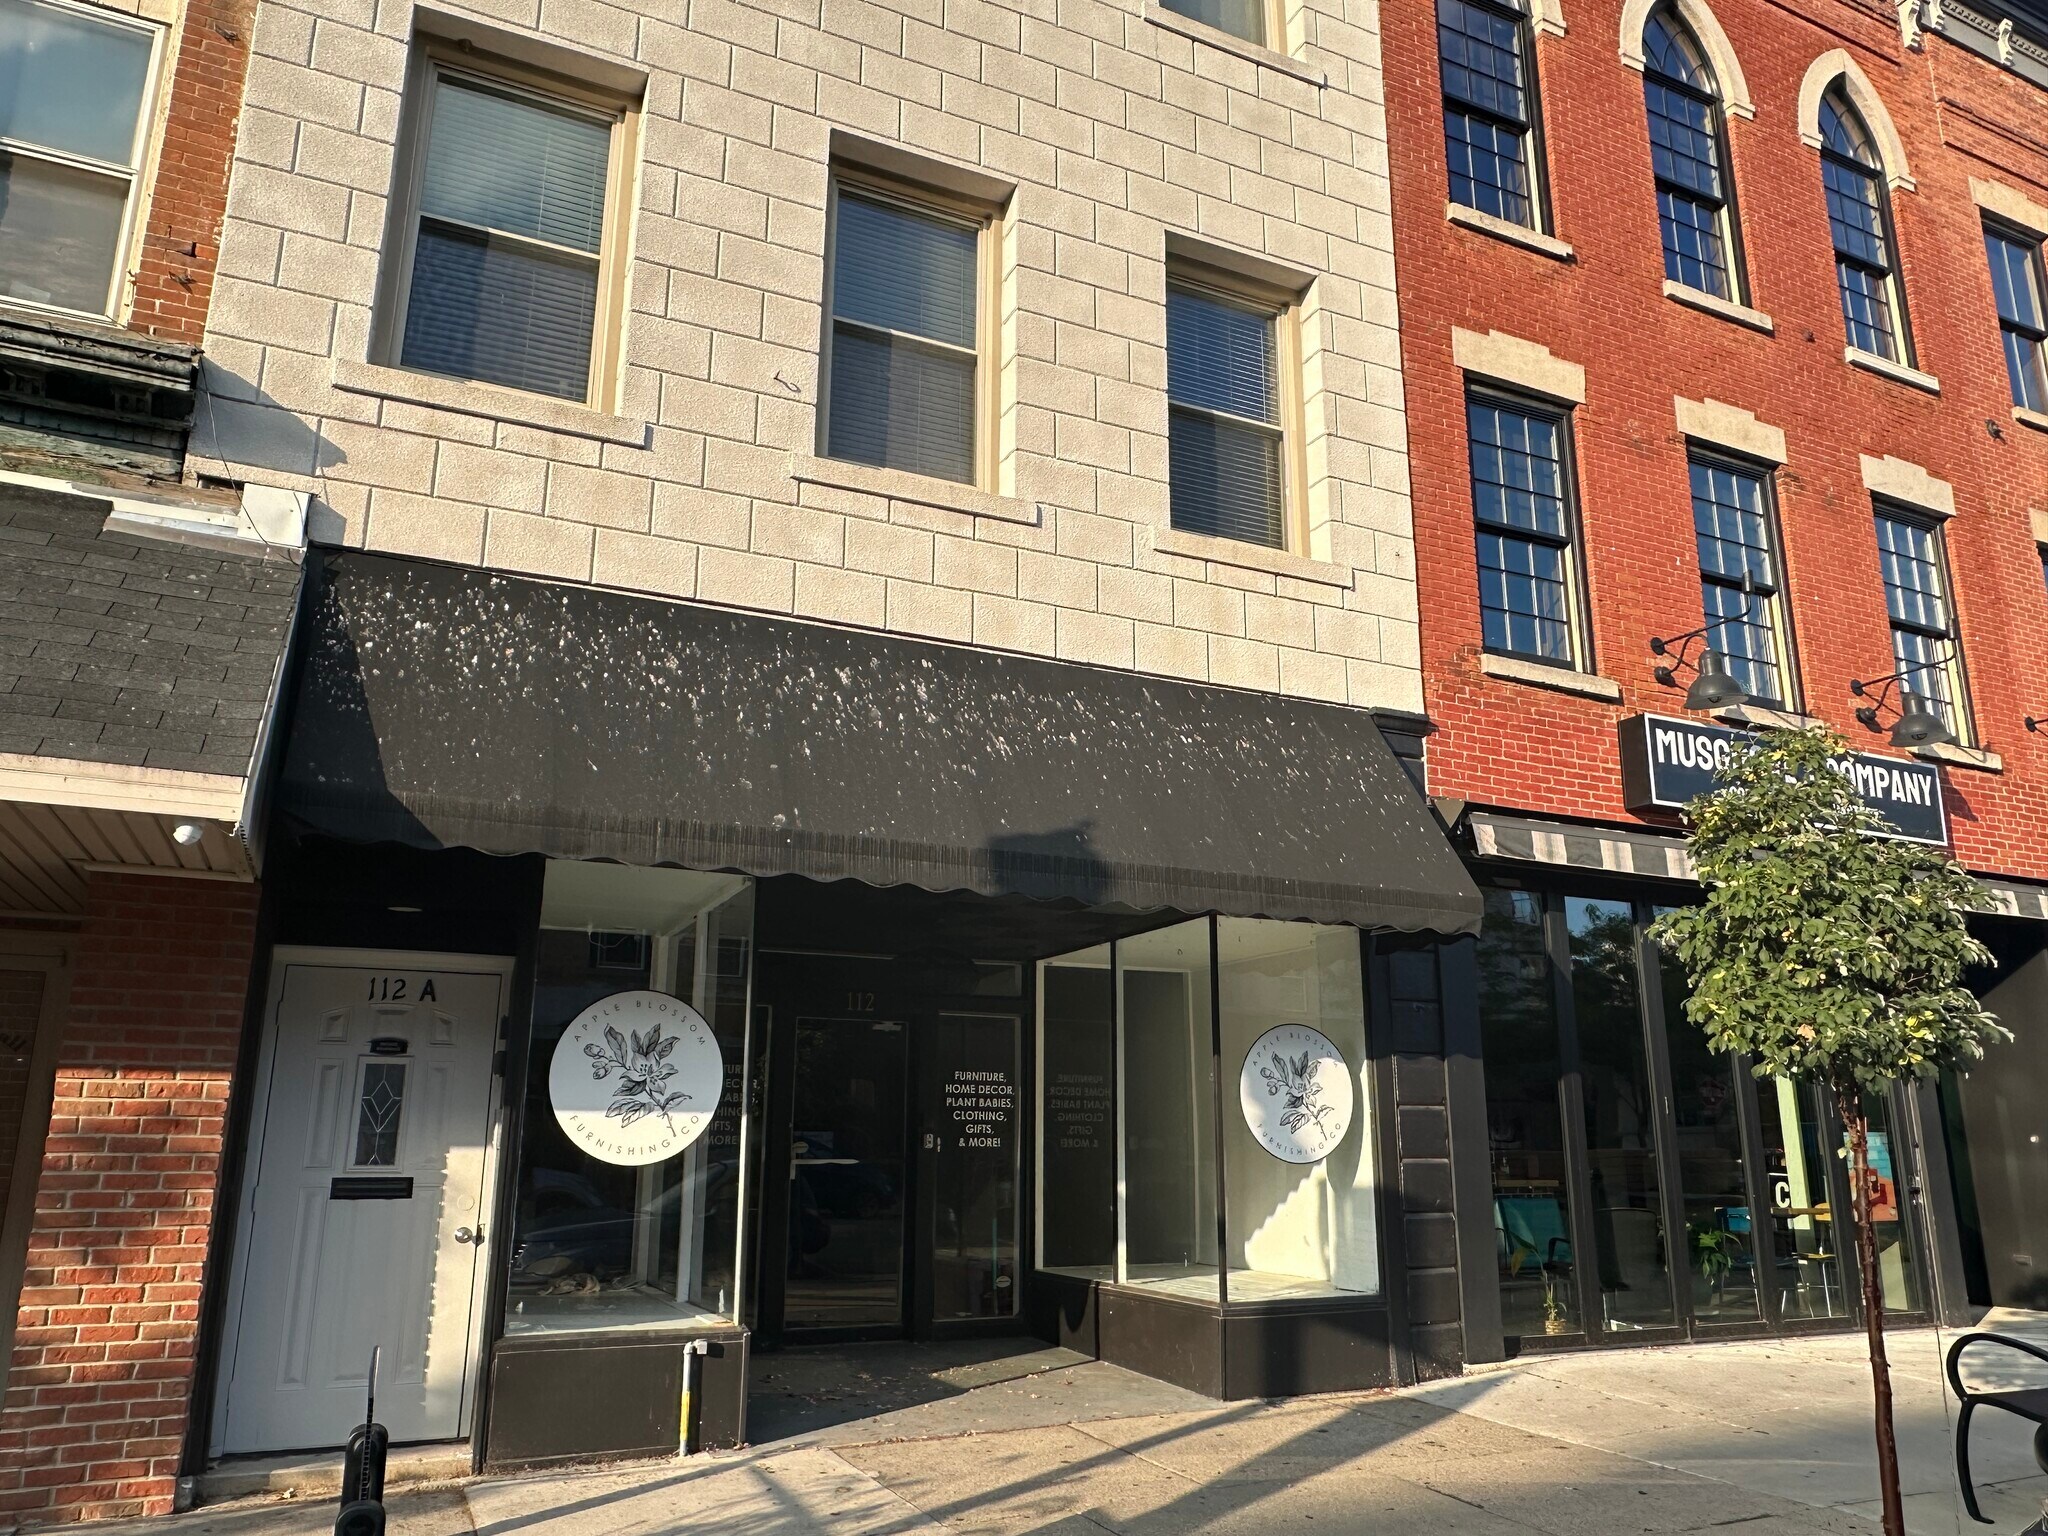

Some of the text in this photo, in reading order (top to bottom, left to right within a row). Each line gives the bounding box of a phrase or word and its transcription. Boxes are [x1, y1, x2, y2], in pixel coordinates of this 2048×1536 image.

[368, 977, 437, 1002] 112 A
[847, 991, 874, 1011] 112
[574, 1000, 706, 1045] APPLE BLOSSOM
[1253, 1034, 1280, 1066] APPLE
[954, 1071, 1007, 1082] FURNITURE,
[945, 1084, 1015, 1095] HOME DECOR,
[946, 1097, 1014, 1108] PLANT BABIES,
[953, 1110, 1007, 1122] CLOTHING,
[570, 1115, 671, 1155] FURNISHING
[965, 1124, 995, 1134] GIFTS,
[958, 1137, 1001, 1147] & MORE!
